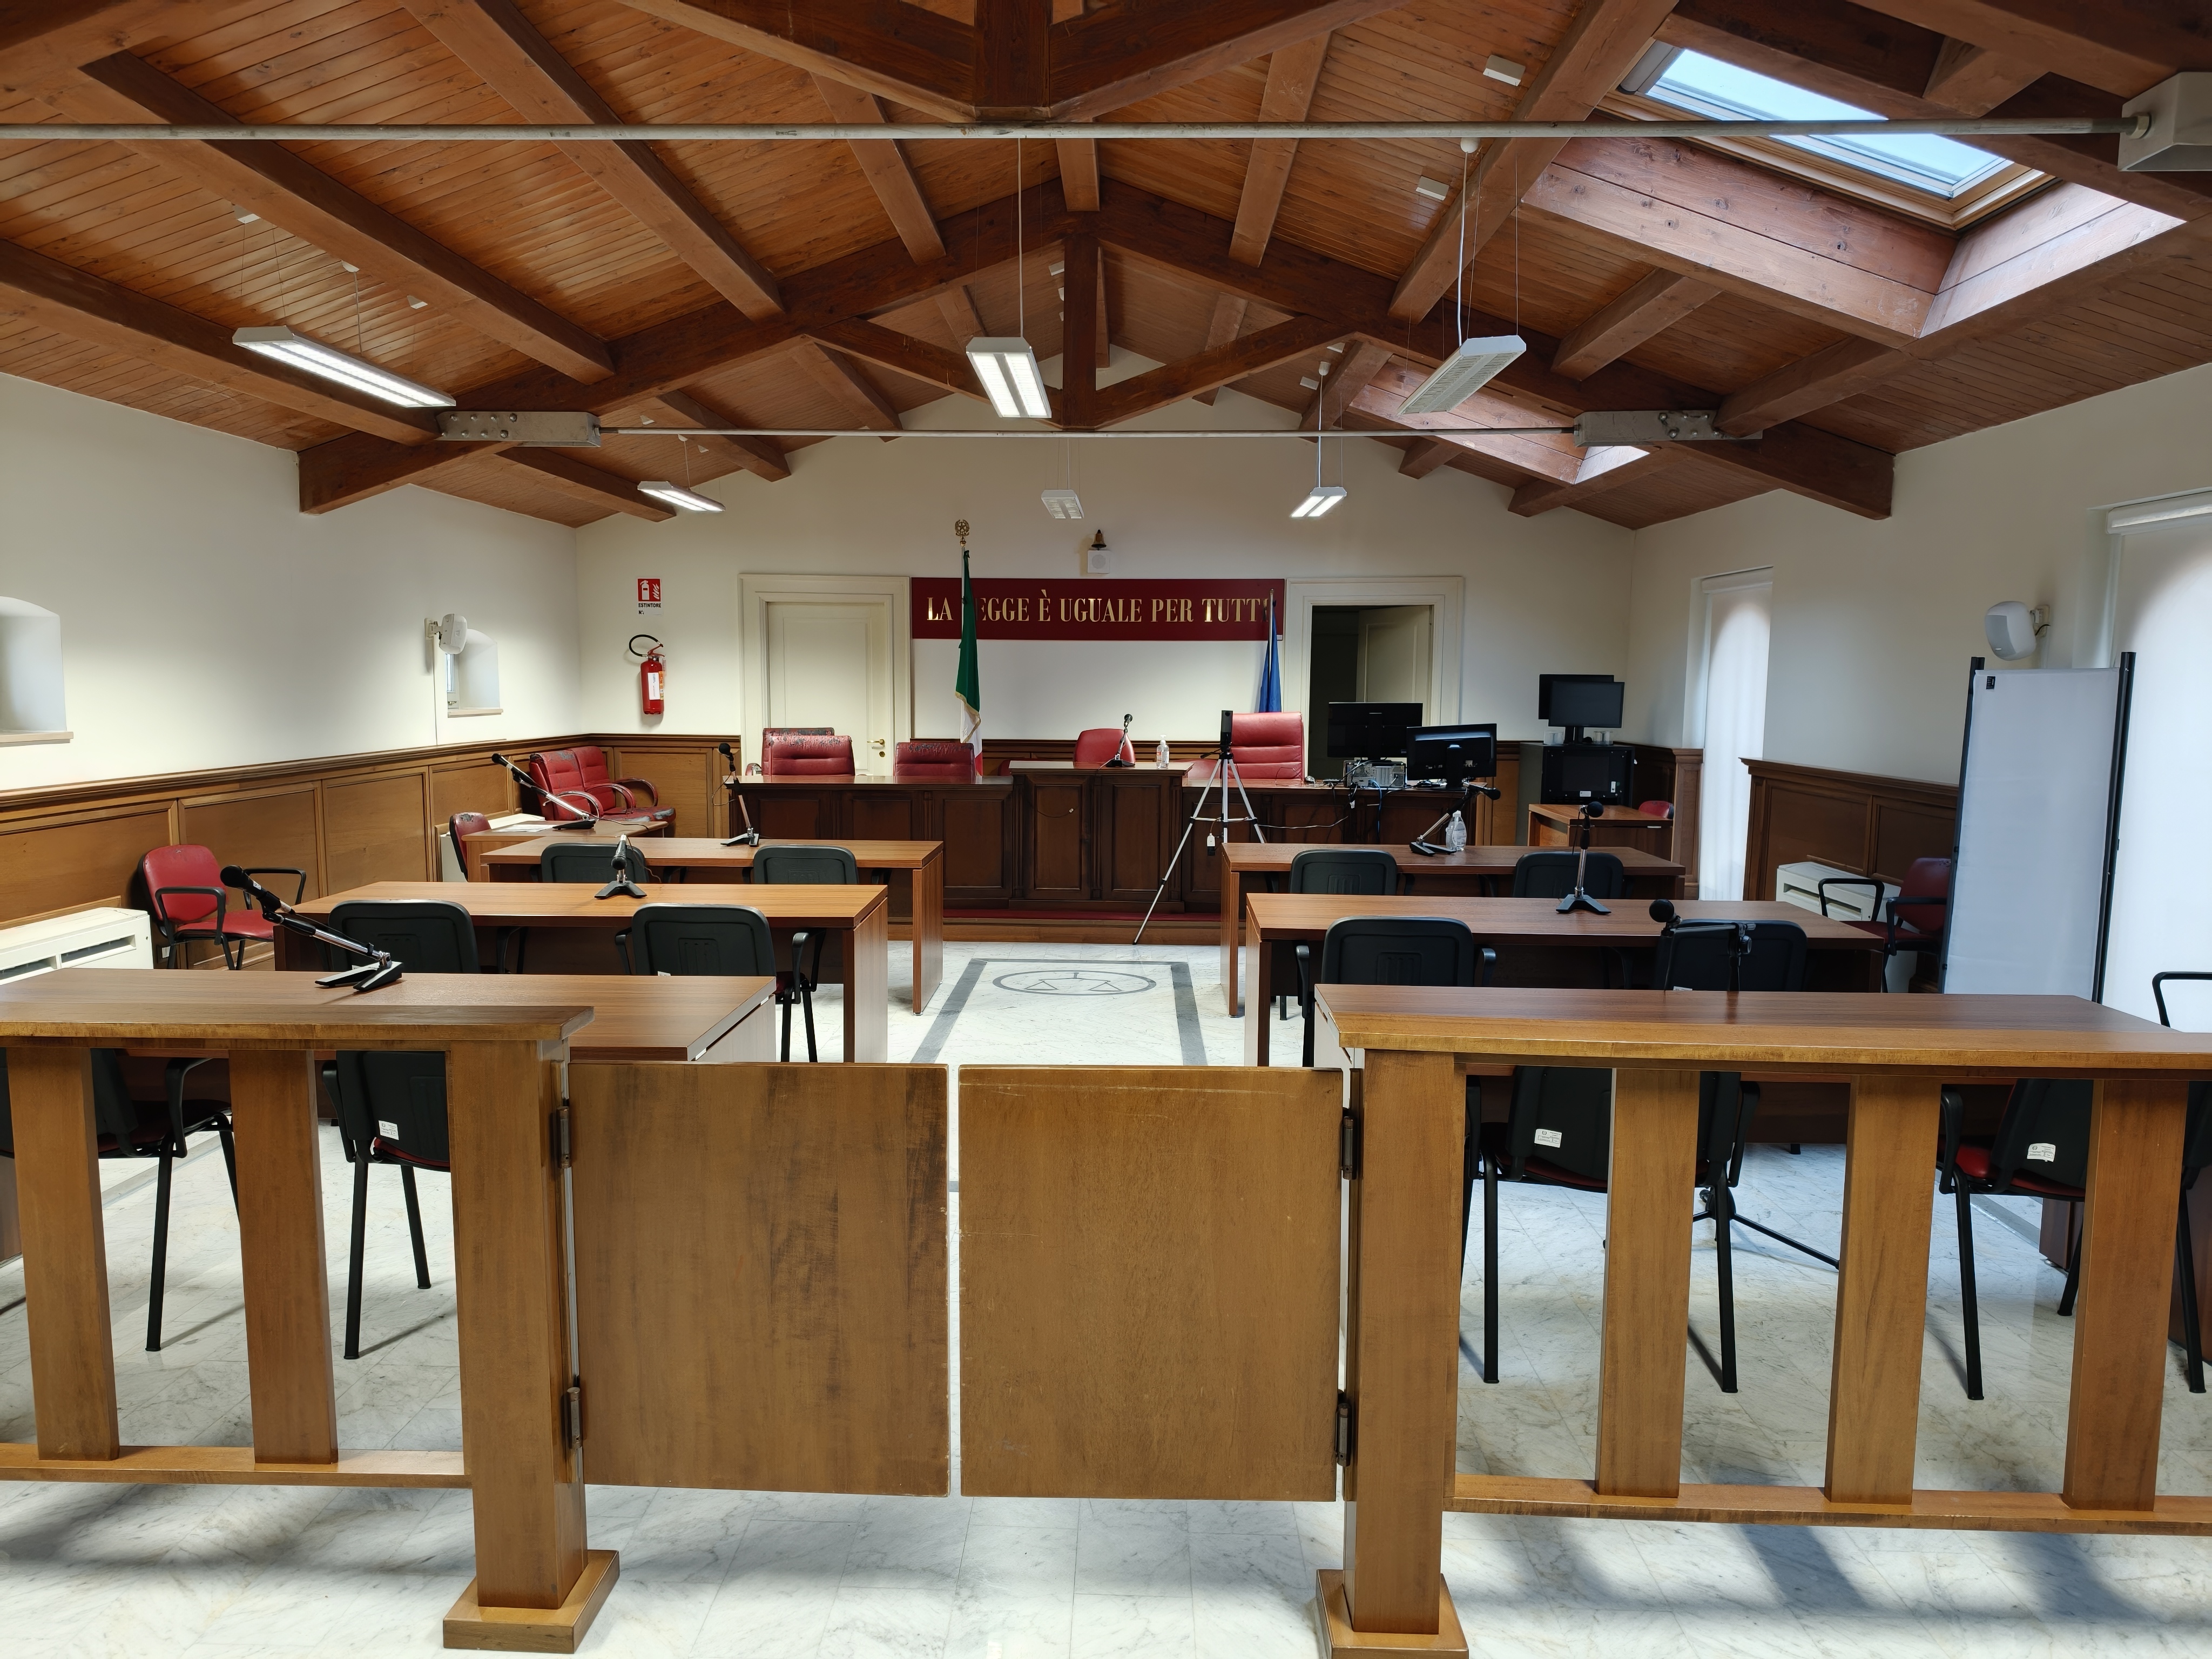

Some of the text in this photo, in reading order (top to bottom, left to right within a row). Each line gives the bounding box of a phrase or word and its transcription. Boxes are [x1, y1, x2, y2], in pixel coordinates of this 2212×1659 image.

[927, 597, 954, 621] LA
[974, 597, 1029, 622] EGGE
[1037, 589, 1050, 622] È
[1059, 598, 1142, 622] UGUALE
[1151, 598, 1193, 622] PER
